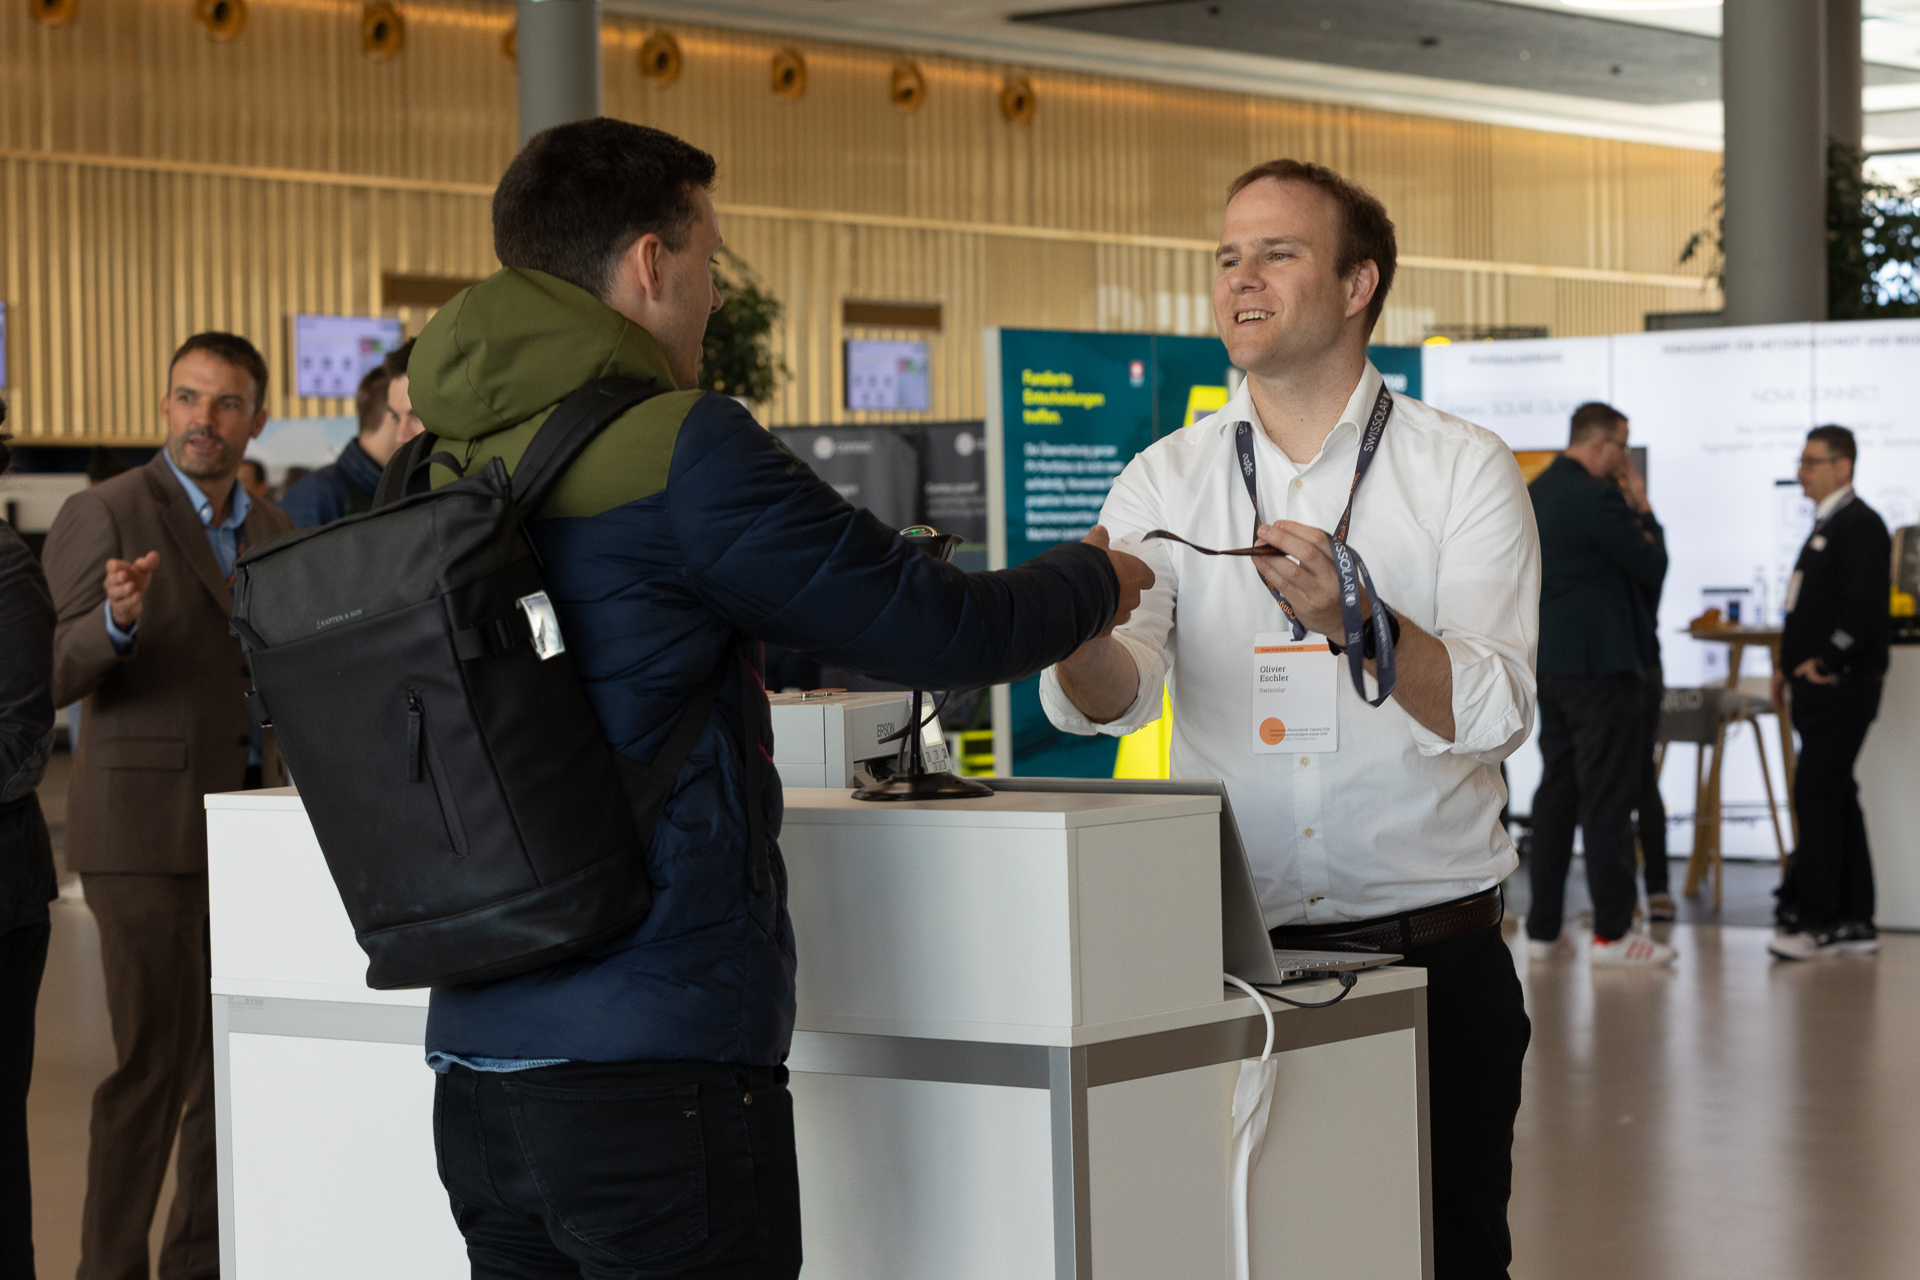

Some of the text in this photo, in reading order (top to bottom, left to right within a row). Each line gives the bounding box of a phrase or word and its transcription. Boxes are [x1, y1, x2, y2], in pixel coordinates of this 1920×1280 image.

[1363, 398, 1391, 452] SWISSOLAR
[1259, 665, 1286, 674] Olivier
[1259, 674, 1289, 682] Eschler
[877, 722, 895, 737] EPSON
